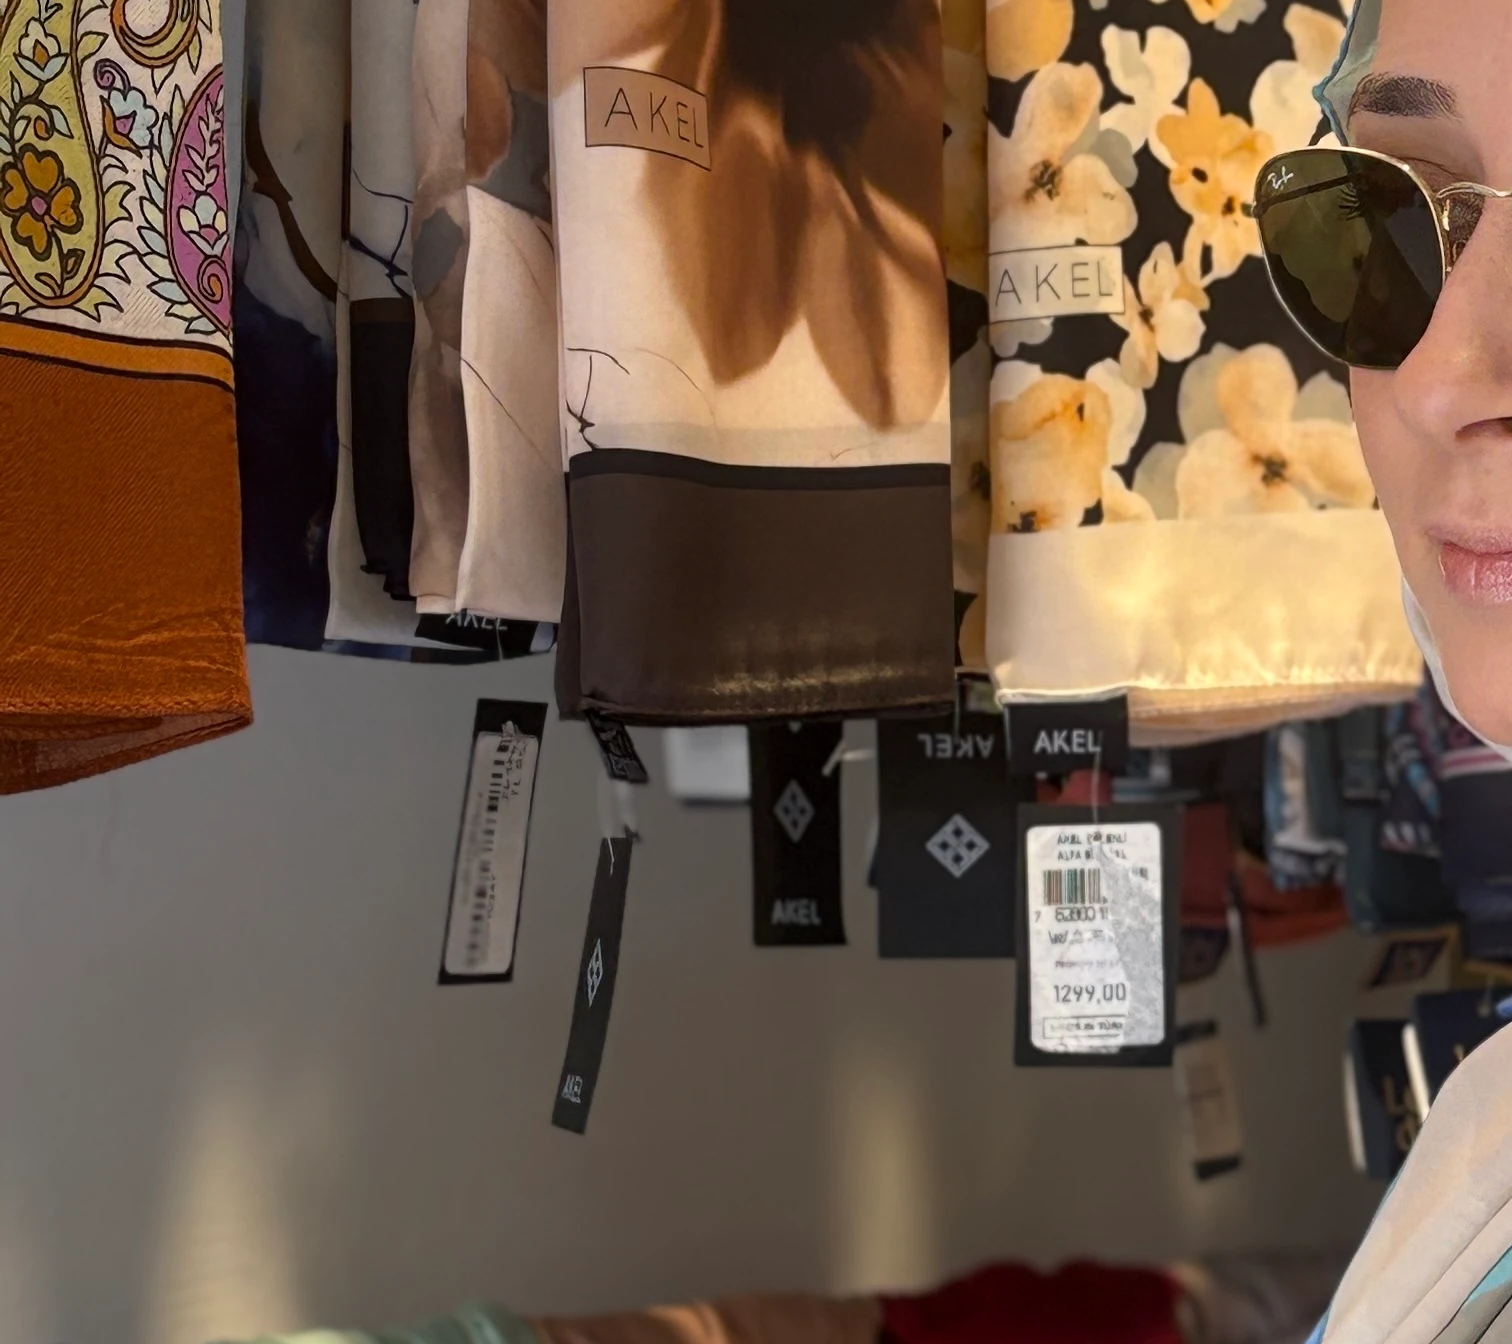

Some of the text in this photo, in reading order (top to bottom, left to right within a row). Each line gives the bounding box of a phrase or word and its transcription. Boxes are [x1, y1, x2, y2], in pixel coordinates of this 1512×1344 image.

[604, 87, 704, 148] AKEL
[995, 260, 1113, 307] AKEL
[917, 733, 994, 758] AKEL
[1033, 729, 1101, 754] AKEL
[771, 899, 821, 925] AKEL
[1053, 983, 1126, 1004] 1299,00
